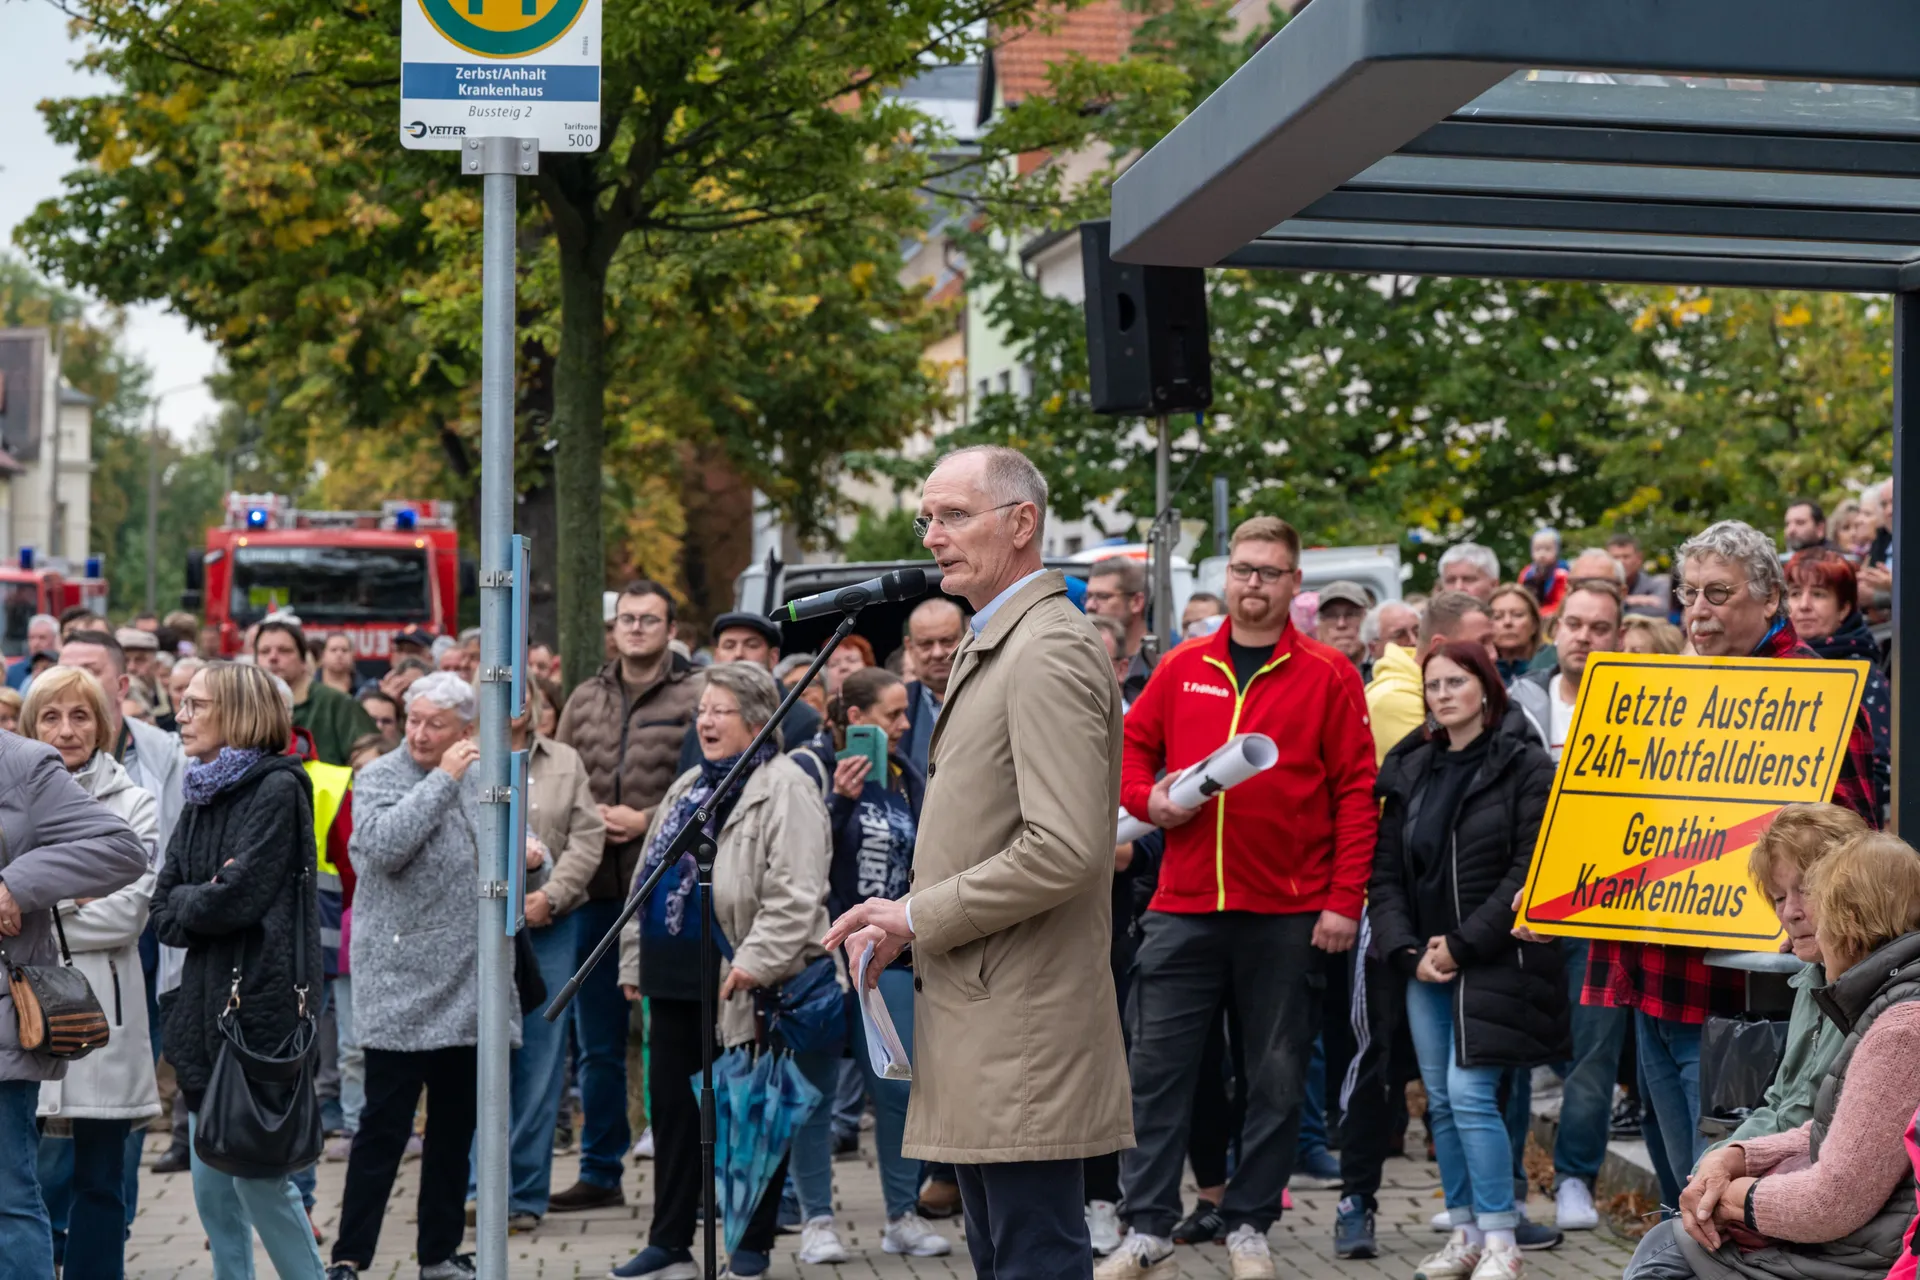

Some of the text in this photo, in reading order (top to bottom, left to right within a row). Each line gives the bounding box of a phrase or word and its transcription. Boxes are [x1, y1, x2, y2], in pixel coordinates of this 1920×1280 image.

[455, 67, 547, 81] Zerbst/Anhalt
[458, 84, 544, 97] Krankenhaus
[468, 105, 533, 120] Bussteig 2
[428, 126, 466, 136] VETTER
[564, 122, 598, 131] Tarifzone
[568, 134, 593, 147] 500
[1605, 681, 1823, 733] letzte Ausfahrt
[1573, 734, 1825, 788] 24h-Notfalldienst
[1622, 812, 1727, 861] Genthin
[1570, 863, 1748, 918] Krankenhaus
